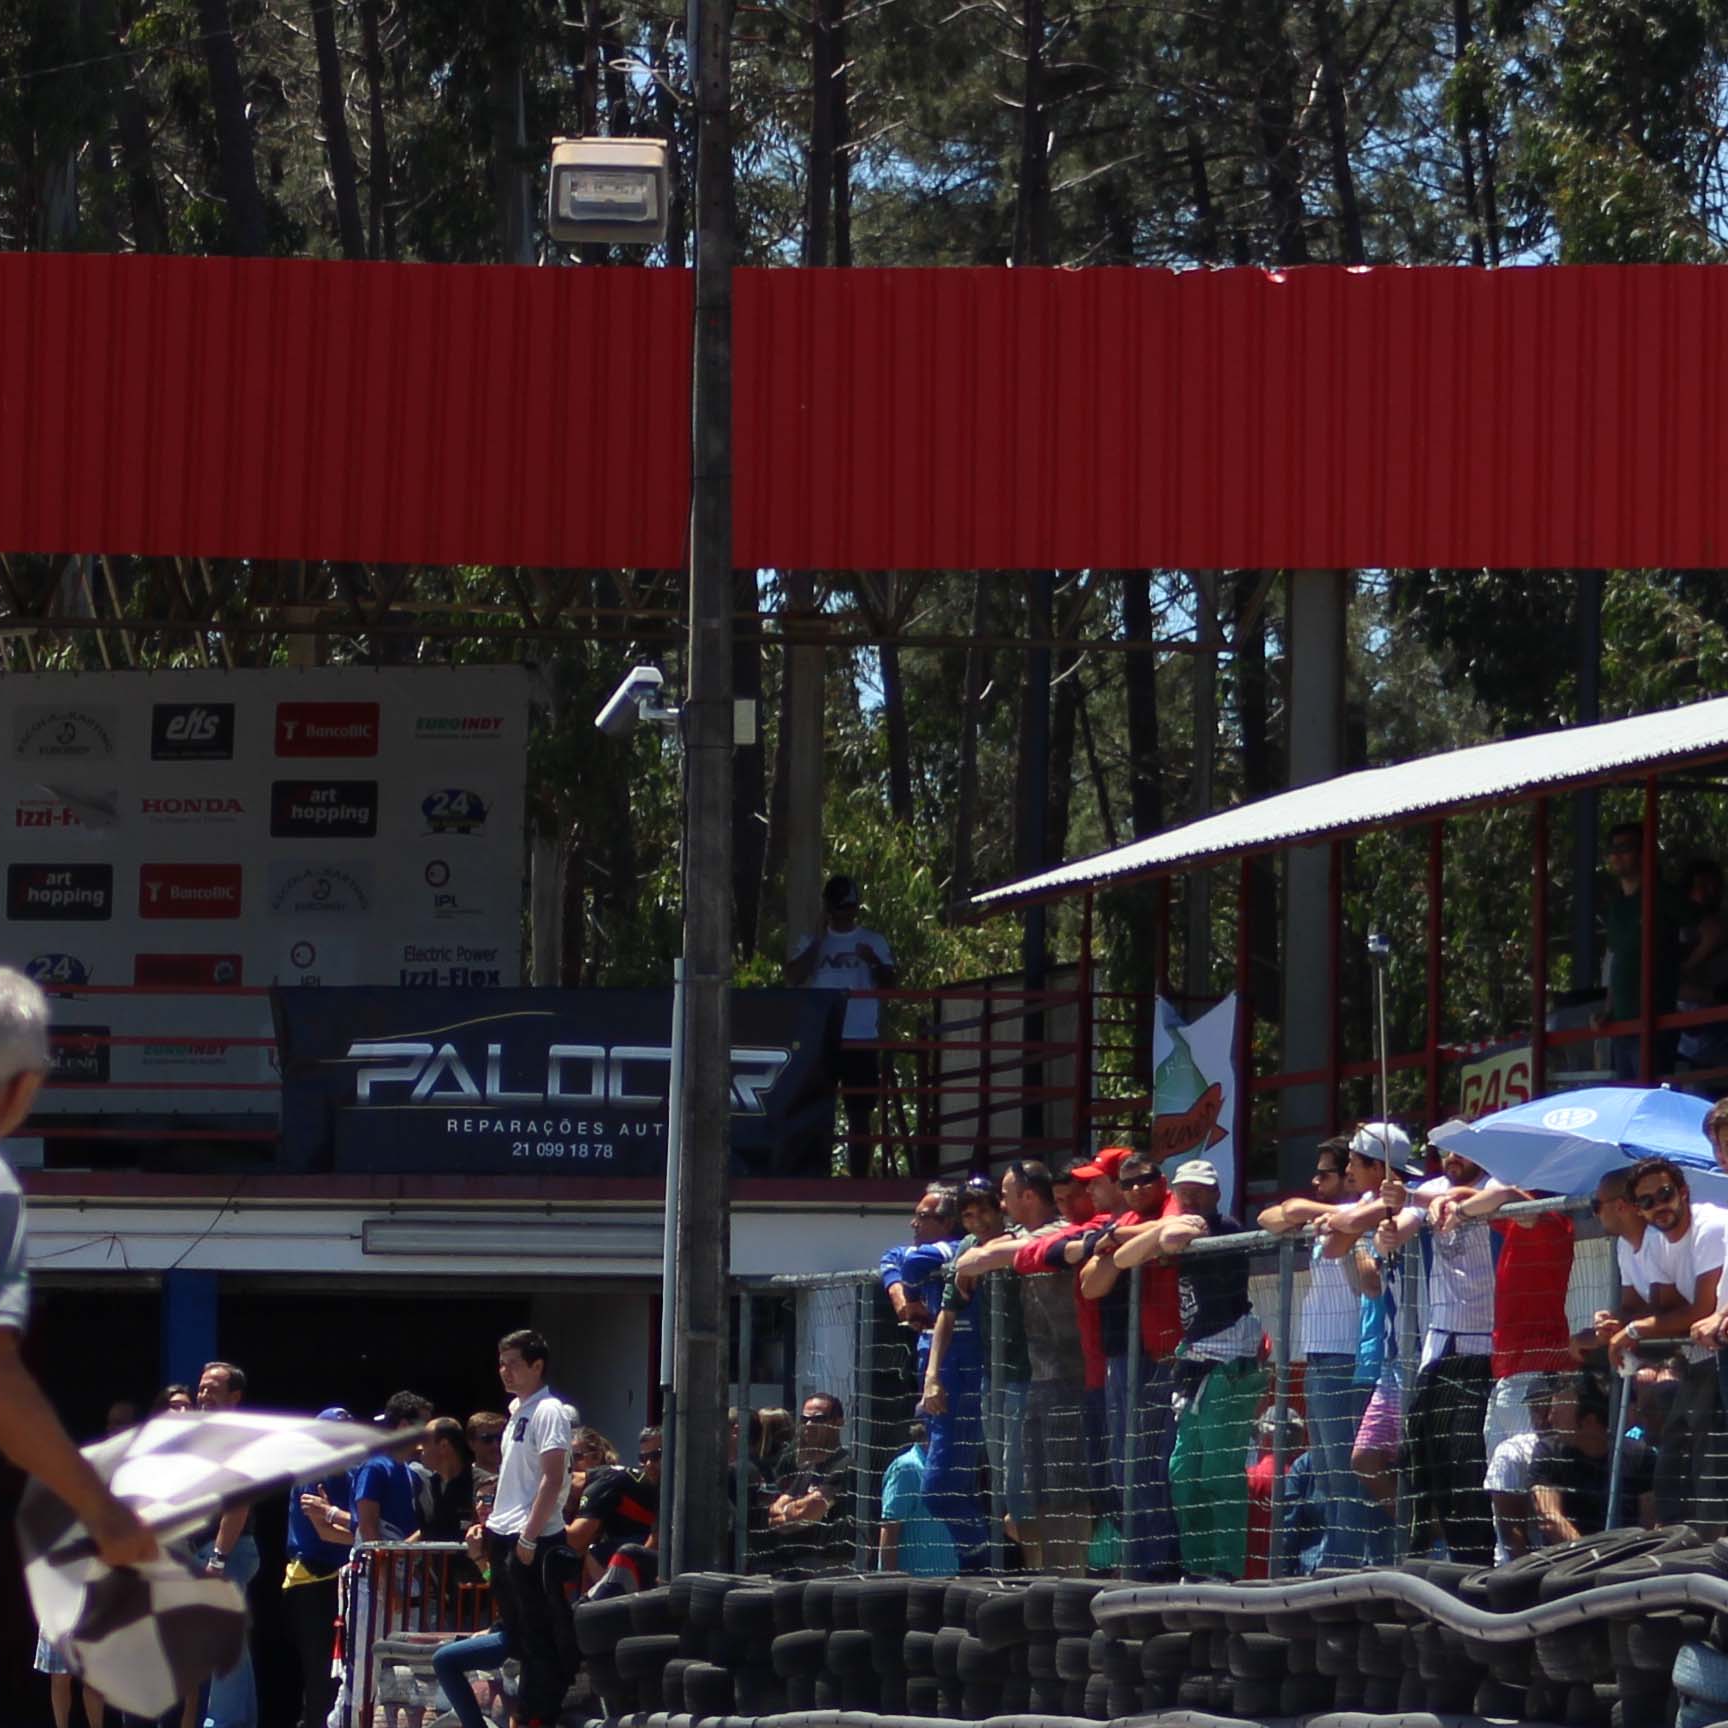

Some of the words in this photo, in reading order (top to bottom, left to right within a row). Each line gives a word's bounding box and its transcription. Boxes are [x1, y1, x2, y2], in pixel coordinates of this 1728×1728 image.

[306, 724, 371, 739] BancoBIC
[416, 716, 504, 731] EUROINDY
[142, 799, 246, 813] HONDA
[432, 791, 469, 816] 24
[404, 945, 451, 963] Electric
[456, 946, 498, 963] Power
[1463, 1062, 1530, 1117] GAS
[446, 1116, 604, 1138] REPARAÇÕES
[619, 1123, 664, 1137] AUT
[512, 1142, 530, 1157] 21
[536, 1142, 565, 1158] 099
[570, 1143, 589, 1158] 18
[594, 1144, 614, 1159] 78
